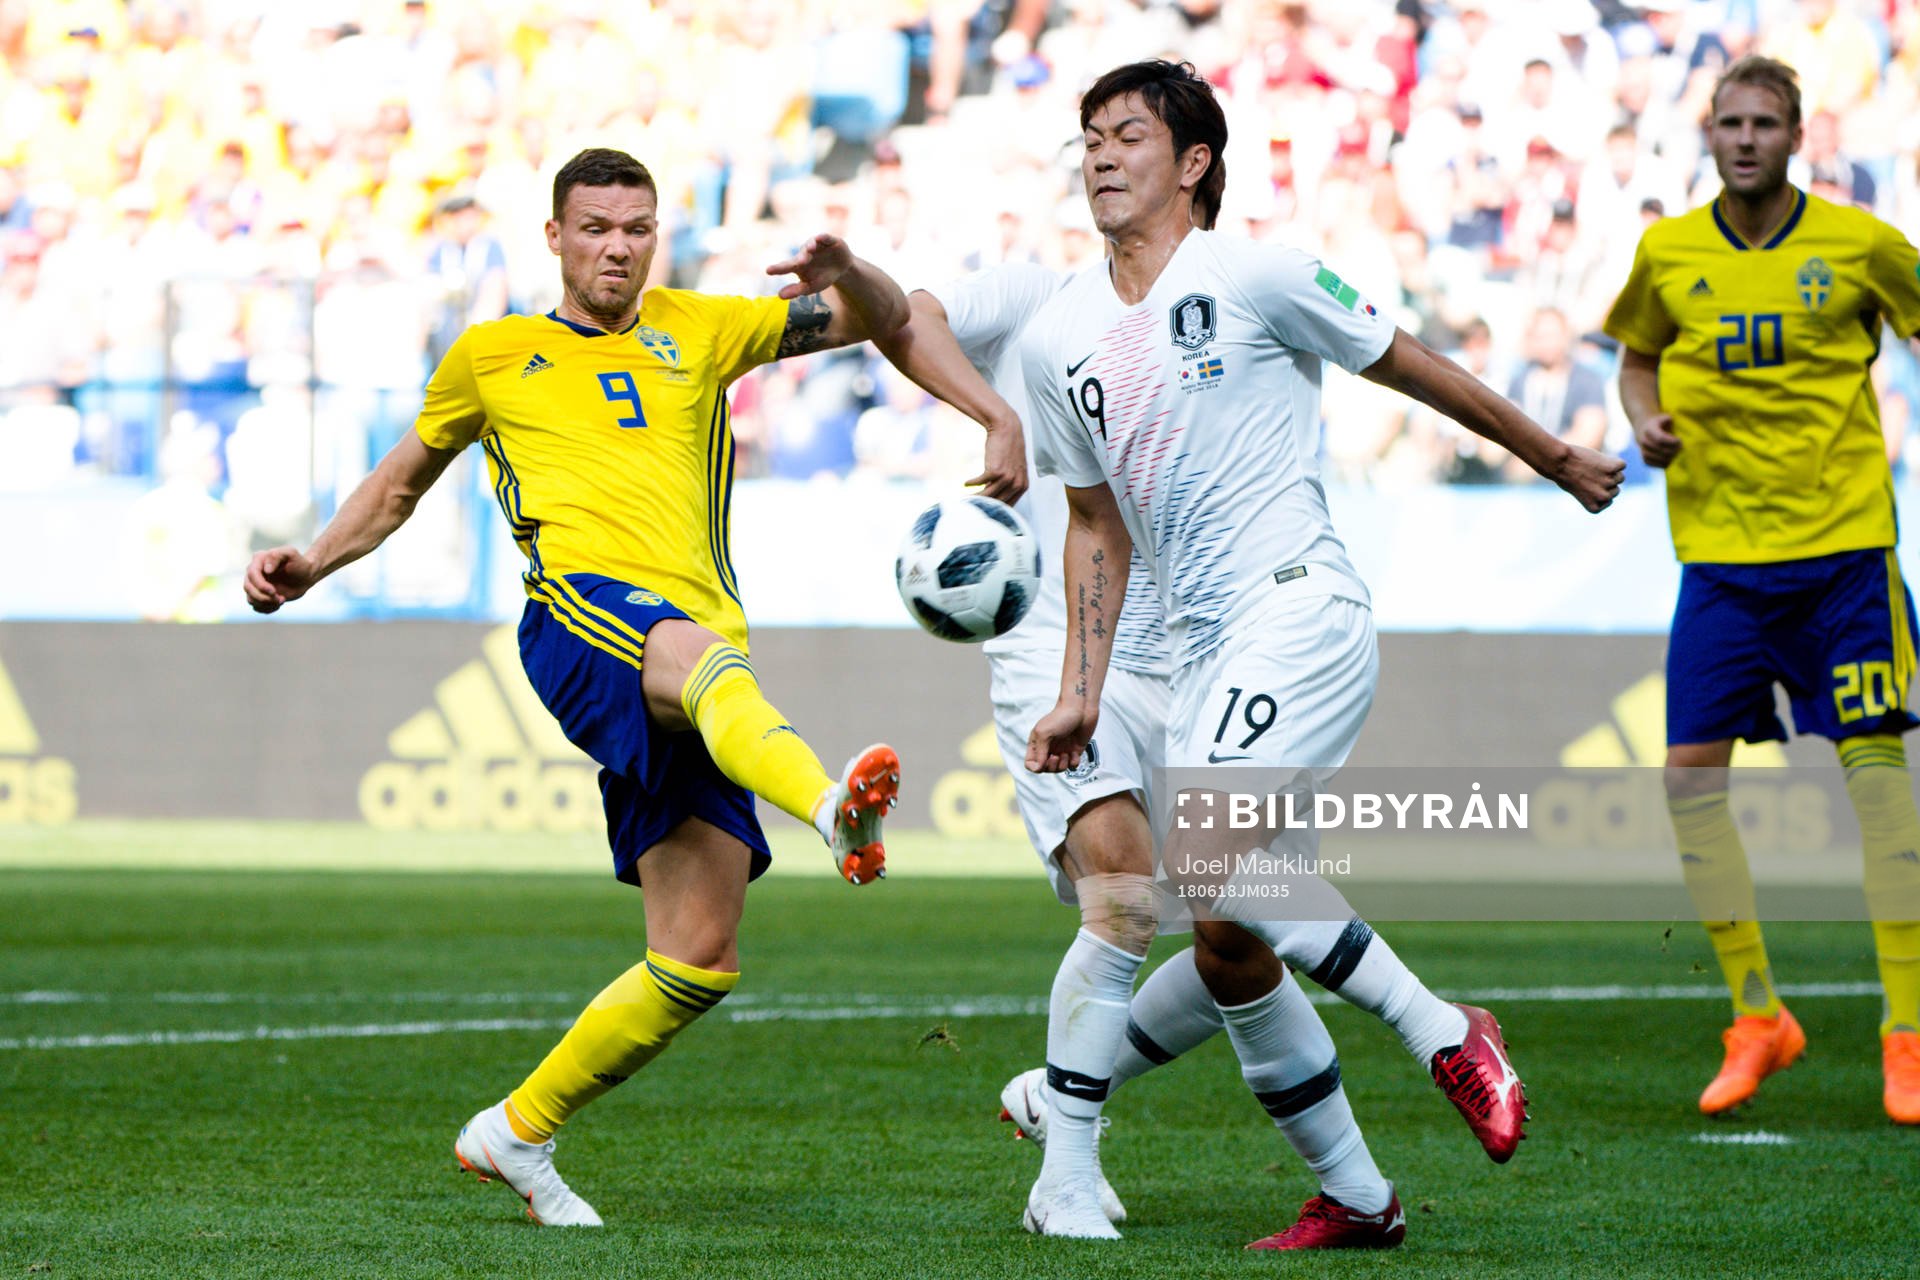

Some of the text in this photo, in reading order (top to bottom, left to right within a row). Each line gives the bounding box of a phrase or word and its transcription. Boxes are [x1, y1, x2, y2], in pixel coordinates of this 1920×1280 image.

[521, 362, 554, 379] adidas
[1182, 350, 1210, 362] KOREA
[1716, 314, 1785, 371] 20
[597, 371, 648, 428] 9
[1067, 377, 1107, 449] 19
[1214, 687, 1278, 749] 19
[1833, 661, 1893, 724] 20
[357, 750, 606, 832] adida
